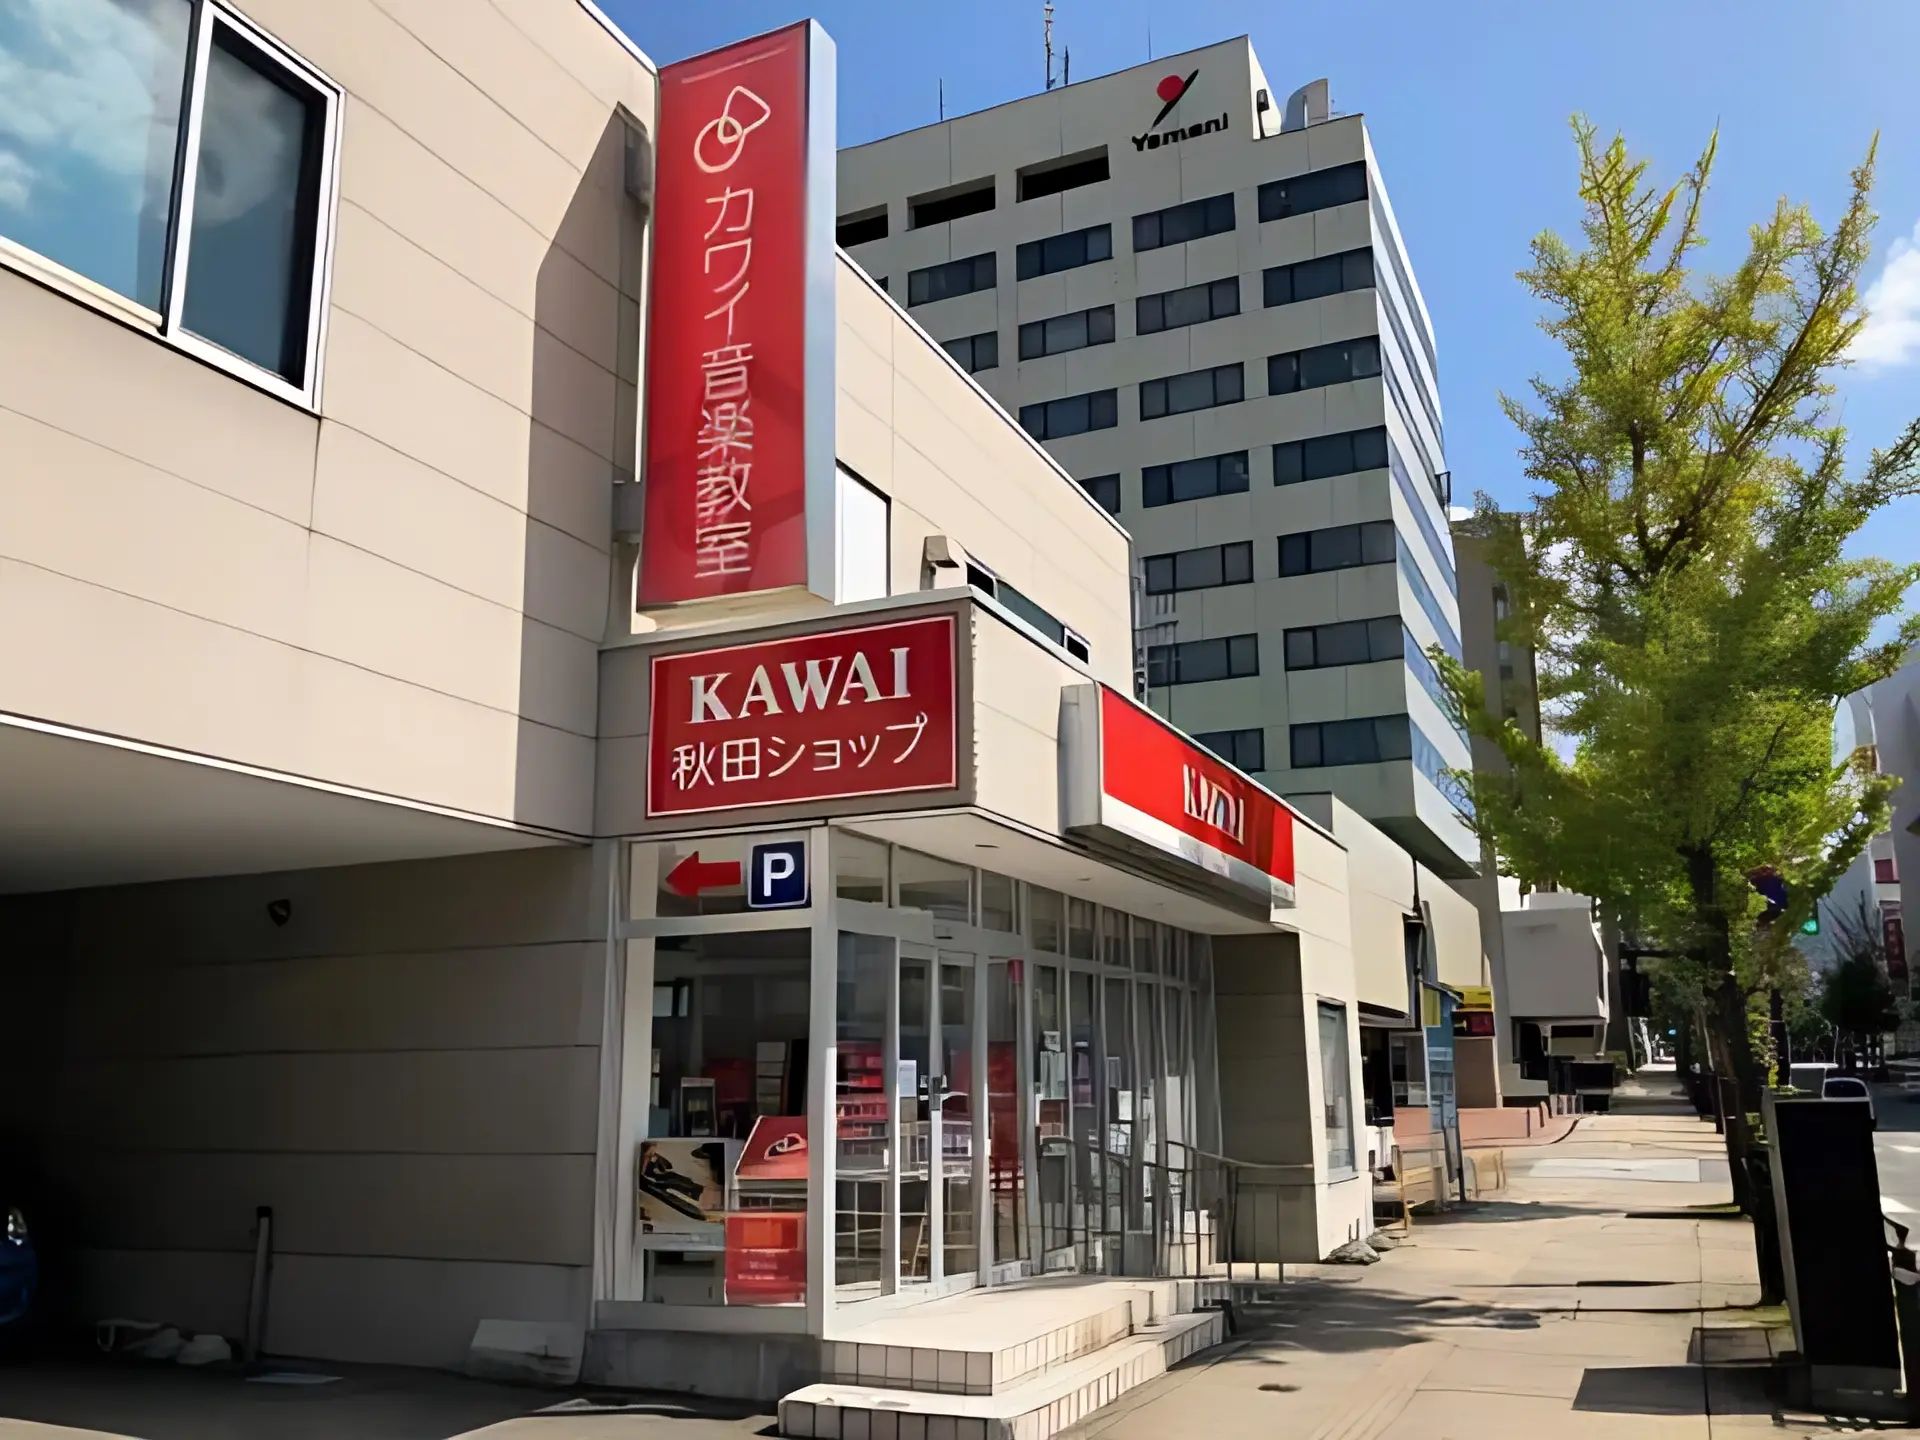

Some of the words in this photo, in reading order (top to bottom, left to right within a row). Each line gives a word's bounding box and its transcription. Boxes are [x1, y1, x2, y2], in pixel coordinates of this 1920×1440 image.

[694, 185, 755, 580] カワイ音楽教室
[685, 647, 912, 725] KAWAI
[671, 711, 929, 791] 秋田ショップ
[763, 852, 796, 897] P
